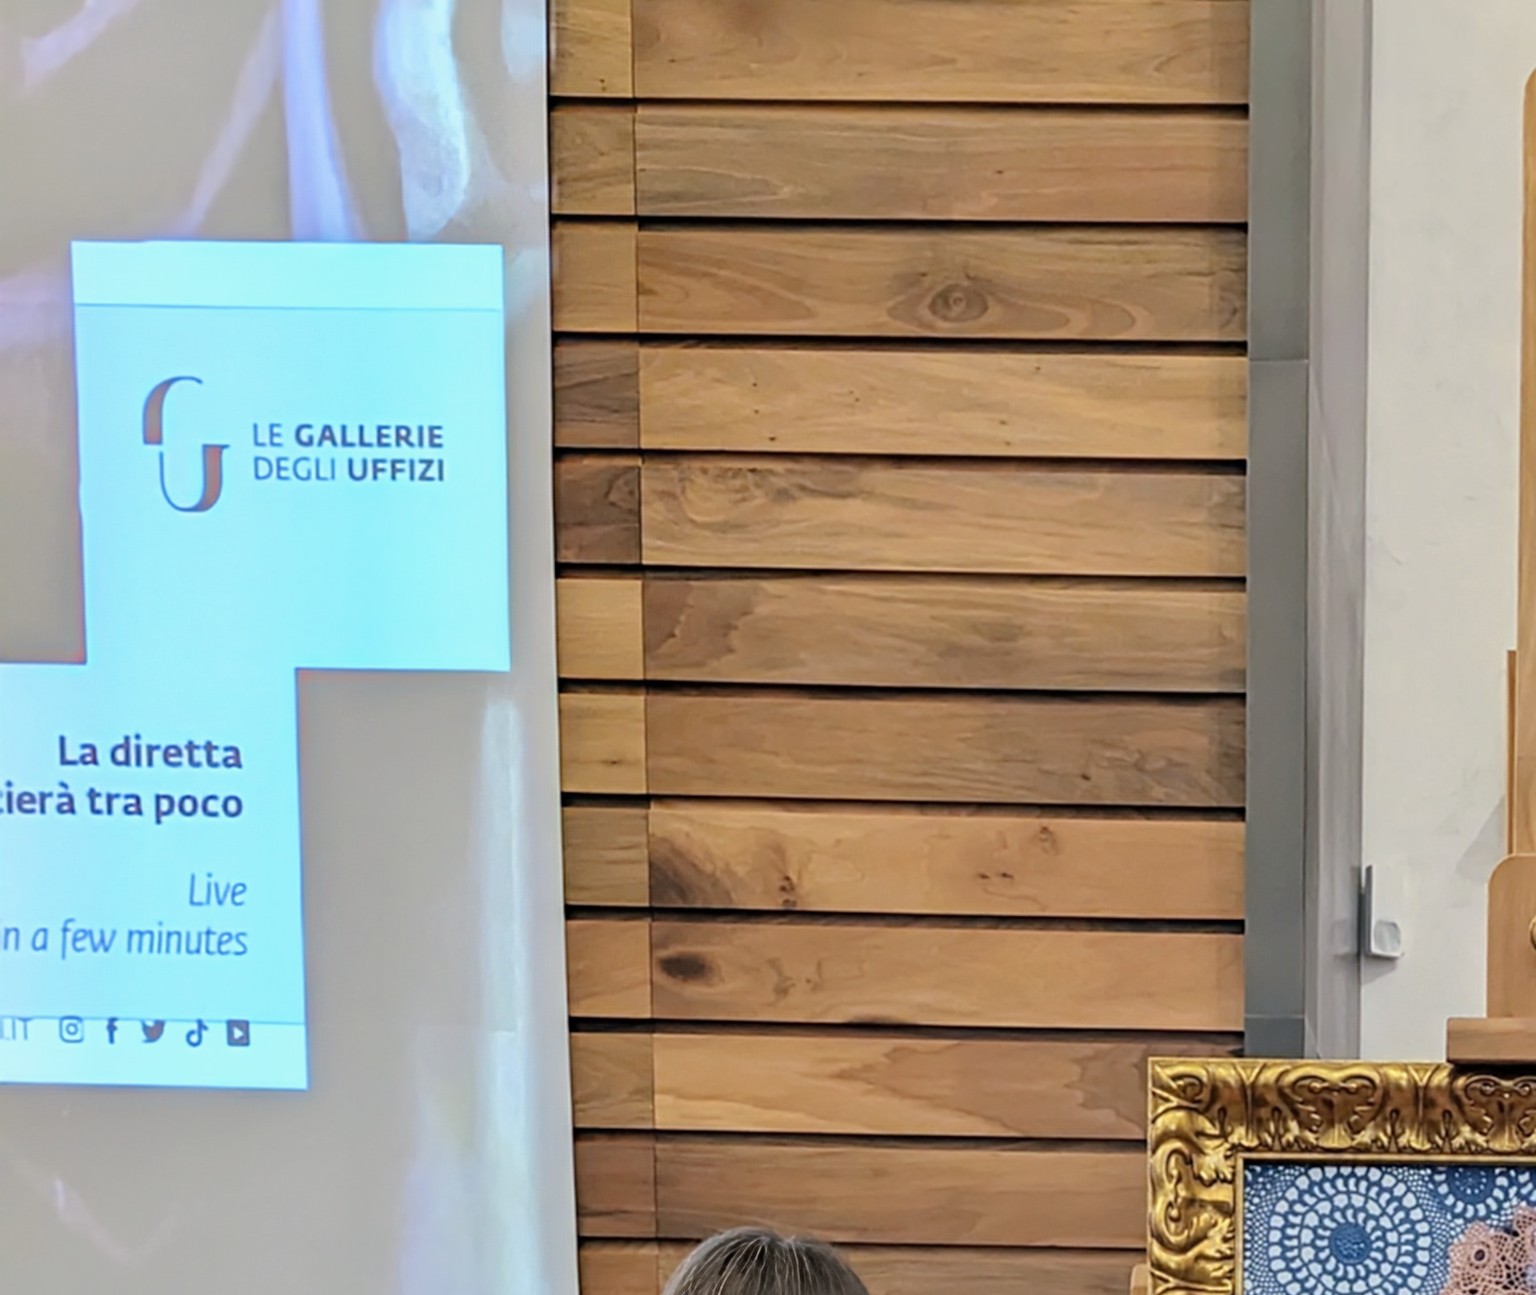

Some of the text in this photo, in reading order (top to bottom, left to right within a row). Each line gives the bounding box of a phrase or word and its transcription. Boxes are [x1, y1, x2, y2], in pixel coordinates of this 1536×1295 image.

[252, 422, 444, 449] LE GALLERIE
[253, 455, 444, 482] DEGLI UFFIZI
[58, 733, 243, 769] La diretta
[0, 780, 244, 825] ierà tra poco
[189, 872, 248, 907] Live
[31, 927, 49, 952] a
[61, 917, 117, 960] few
[127, 921, 248, 956] minutes
